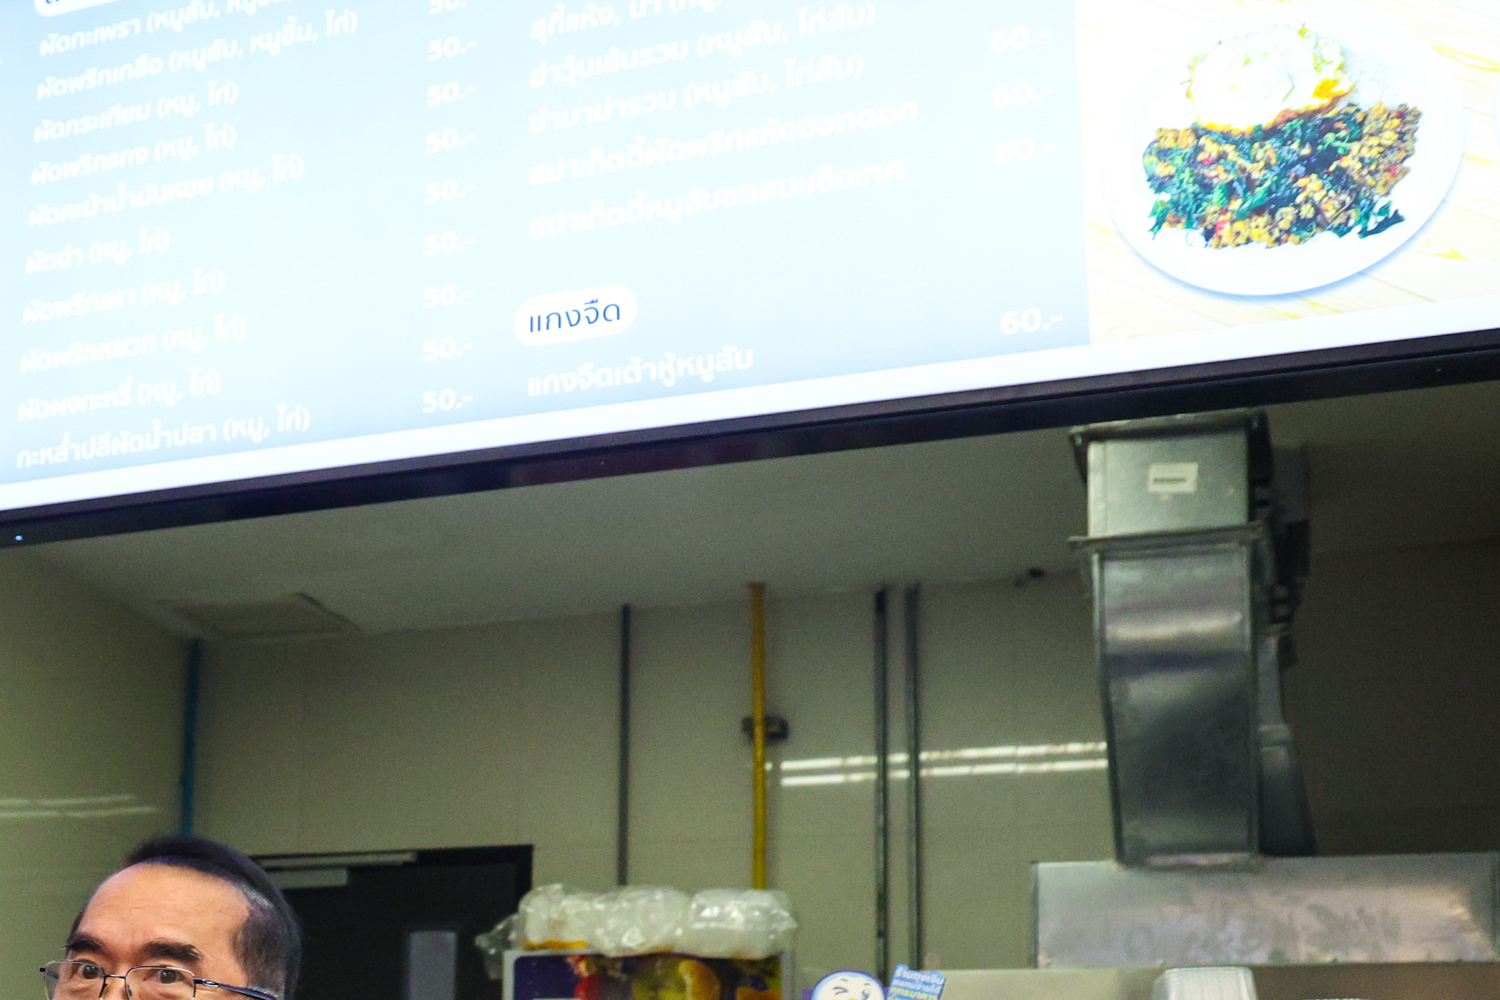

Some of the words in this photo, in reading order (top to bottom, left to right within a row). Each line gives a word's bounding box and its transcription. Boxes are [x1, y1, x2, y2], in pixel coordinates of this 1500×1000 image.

[528, 299, 622, 335] แกงจืด
[1000, 307, 1063, 335] 60.-
[527, 345, 754, 397] แกงจืดเต้าหู้หมูสับ
